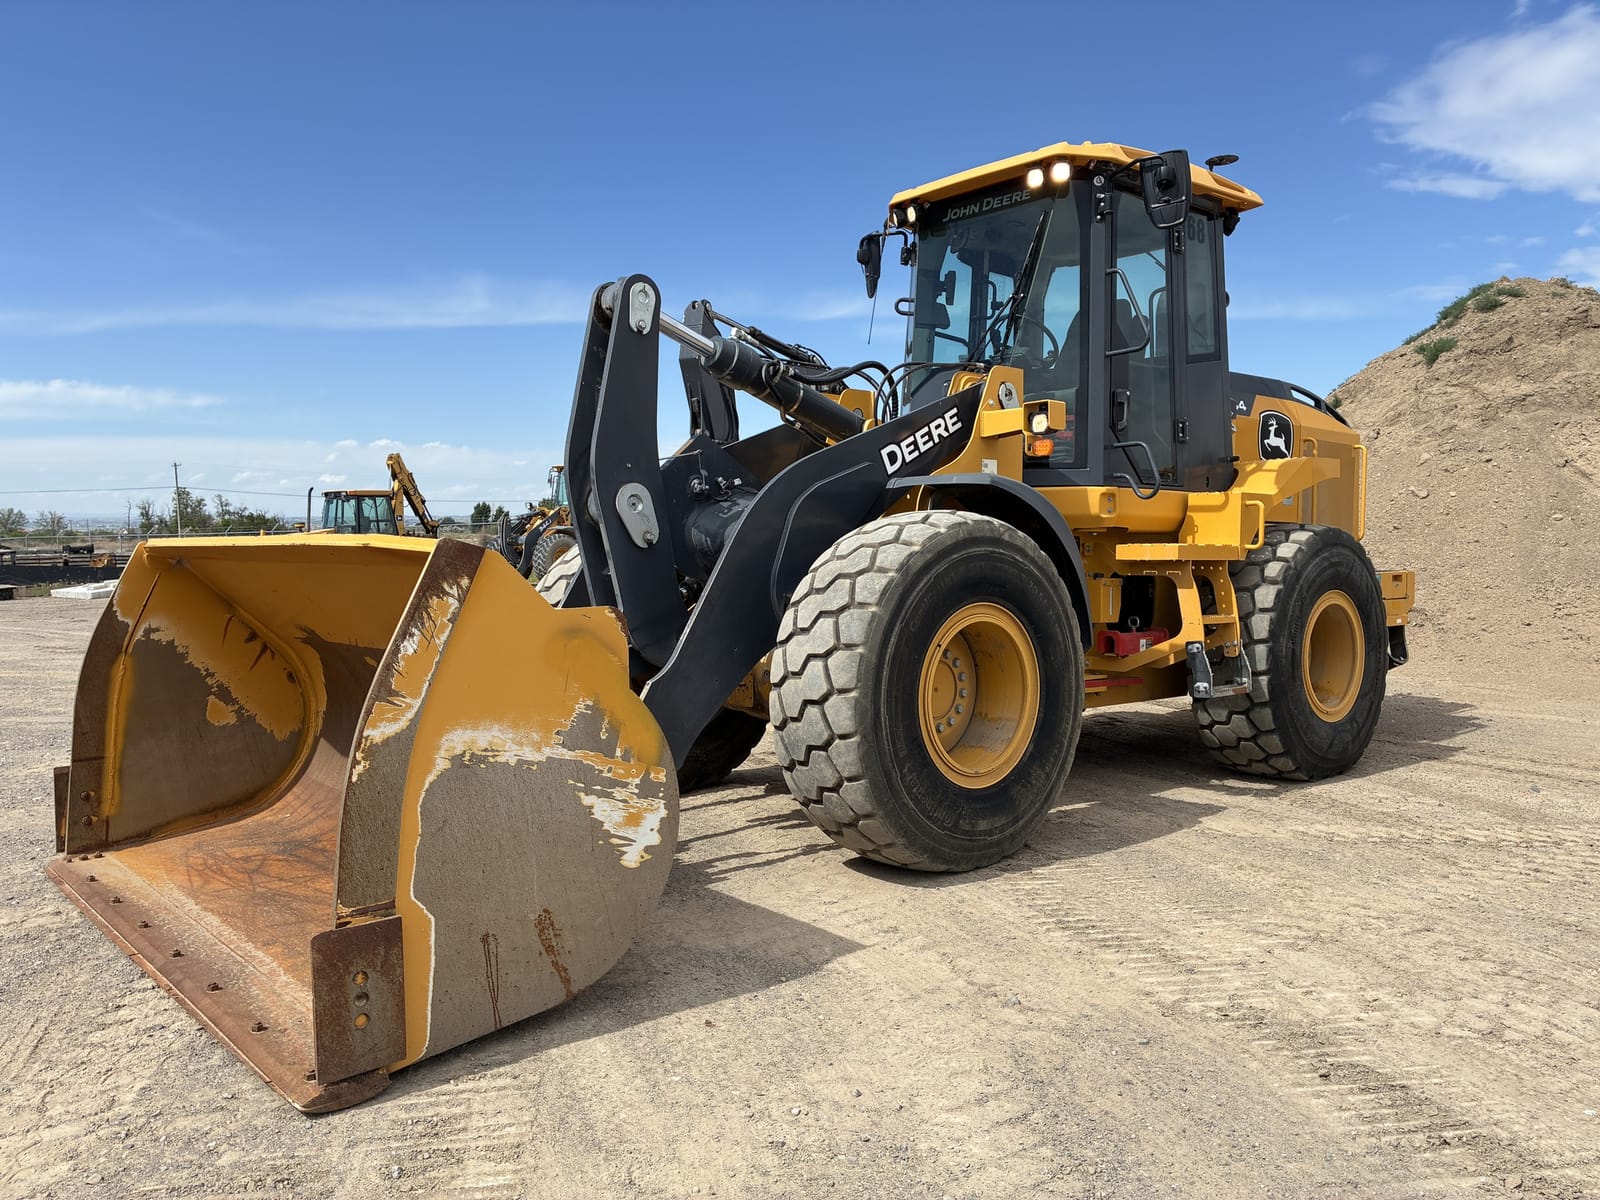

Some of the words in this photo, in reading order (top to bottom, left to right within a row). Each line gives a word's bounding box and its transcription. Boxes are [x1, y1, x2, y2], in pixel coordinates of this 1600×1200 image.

[942, 201, 980, 222] JOHN
[982, 189, 1032, 211] DEERE
[880, 406, 963, 475] DEERE
